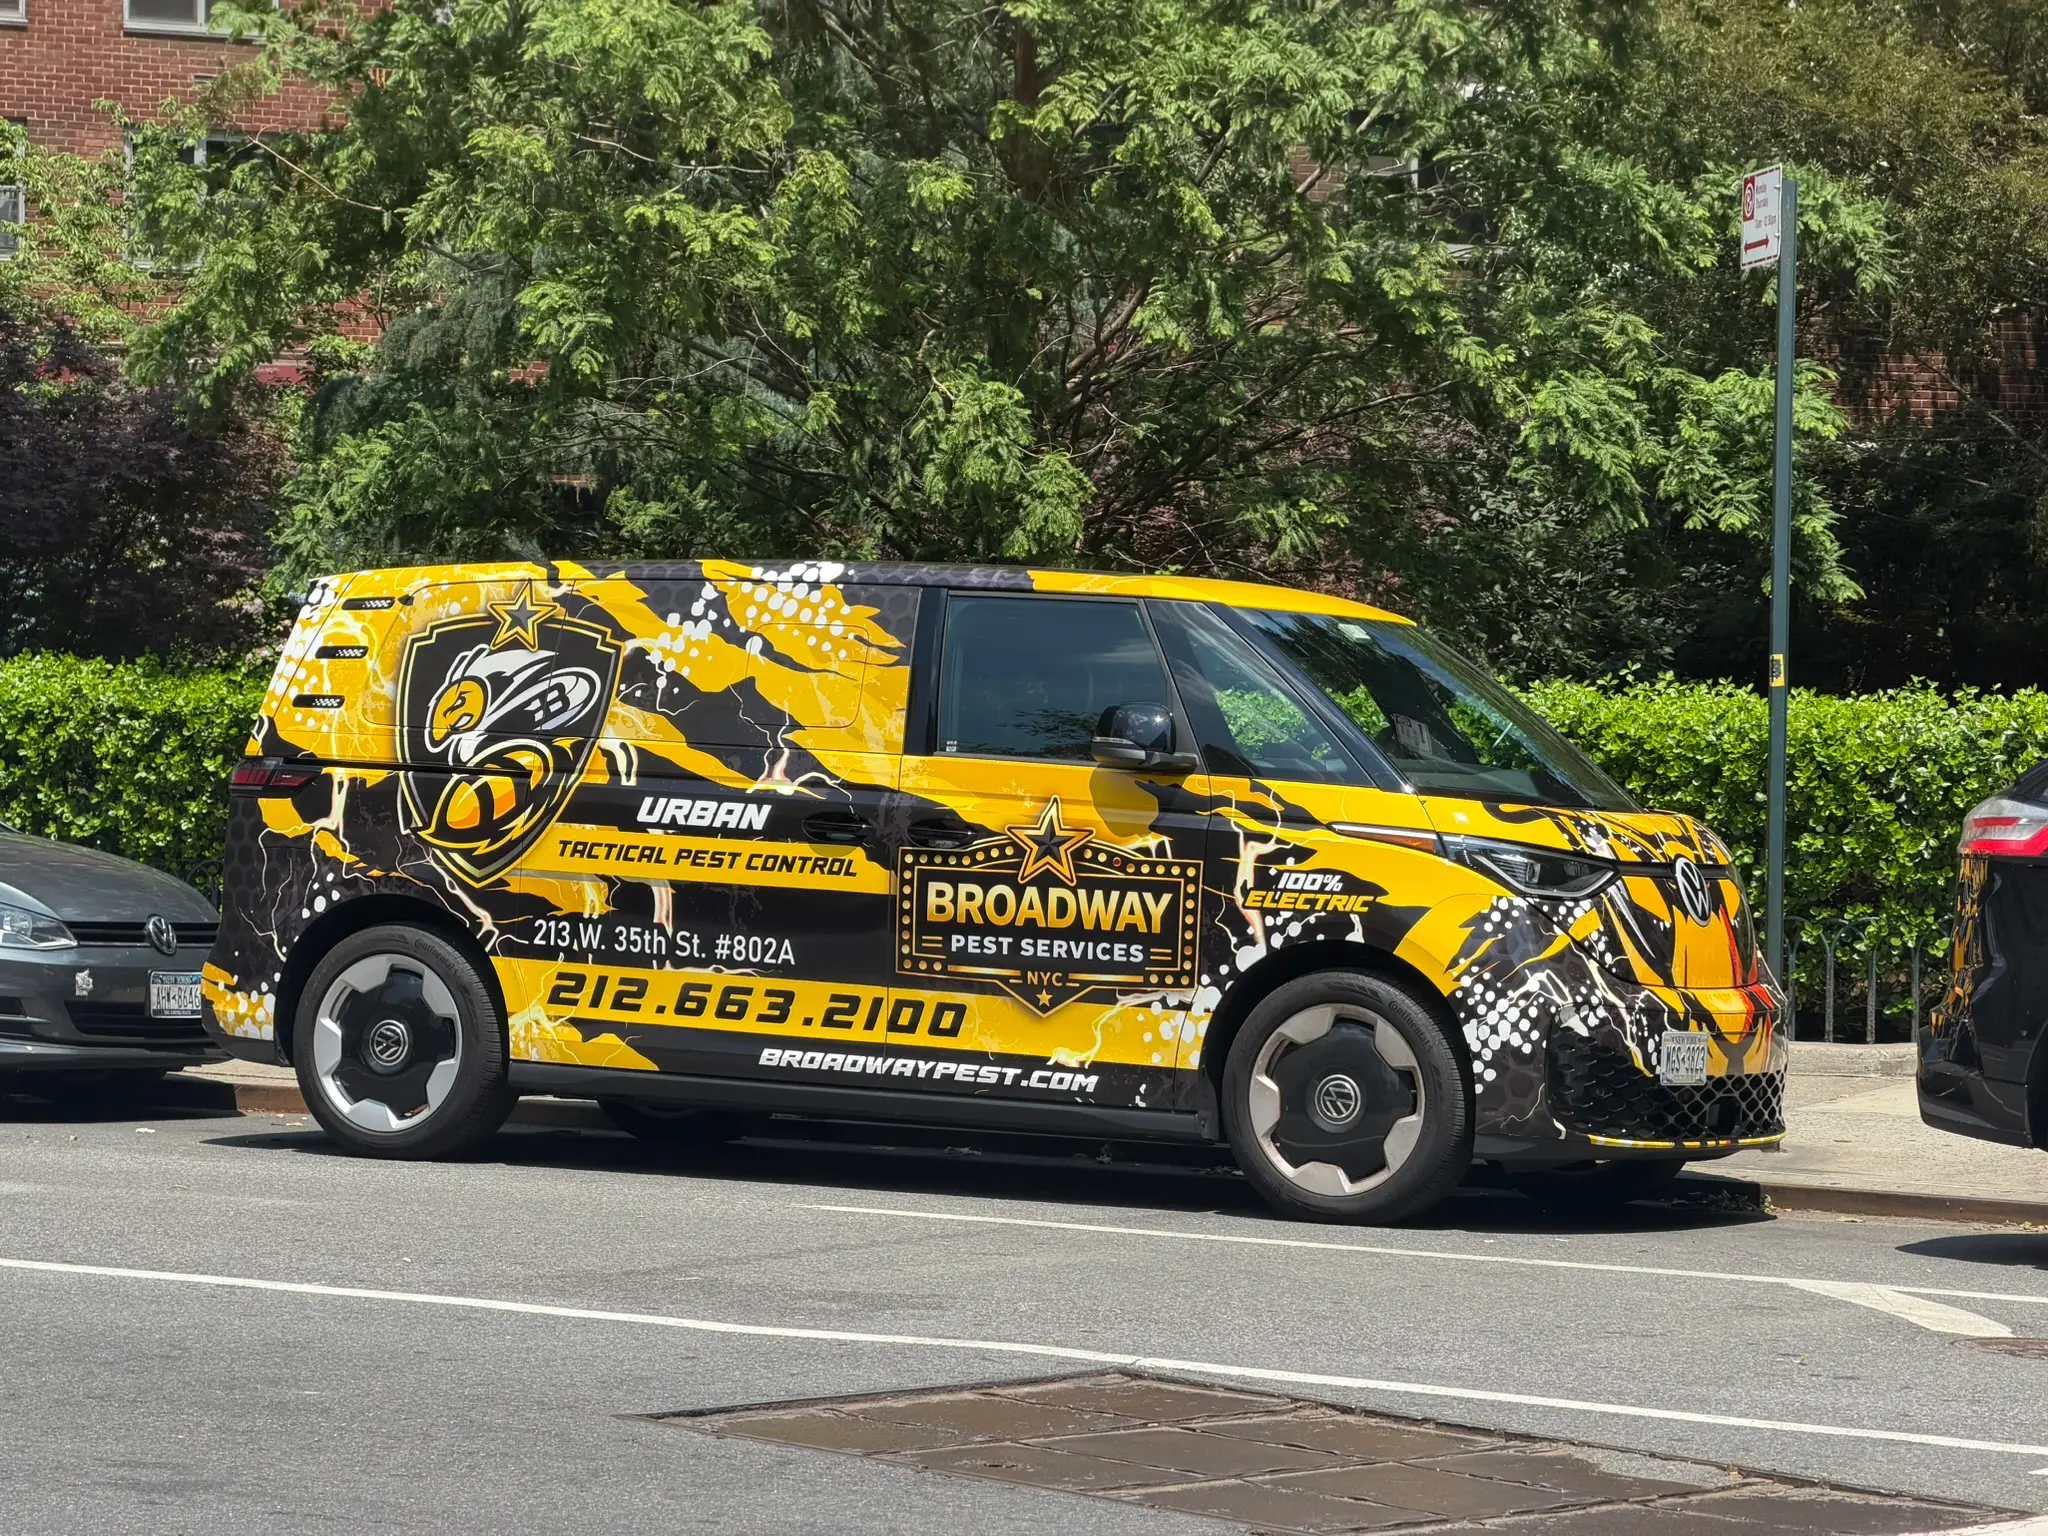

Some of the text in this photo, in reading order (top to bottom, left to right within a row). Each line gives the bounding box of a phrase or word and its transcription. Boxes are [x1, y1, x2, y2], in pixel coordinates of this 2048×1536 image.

[636, 796, 772, 831] URBAN
[558, 839, 858, 877] TACTICAL PEST CONTROL
[1277, 872, 1344, 892] 100%
[926, 881, 1173, 934] BROADWAY
[1244, 890, 1375, 913] ELECTRIC
[533, 919, 796, 966] 213 W. 35th St. #802A
[951, 934, 1144, 963] PEST SERVICES
[1027, 971, 1063, 987] NYC
[547, 971, 968, 1037] 212.663.2100
[758, 1048, 1099, 1092] BROADWAYPEST.COM
